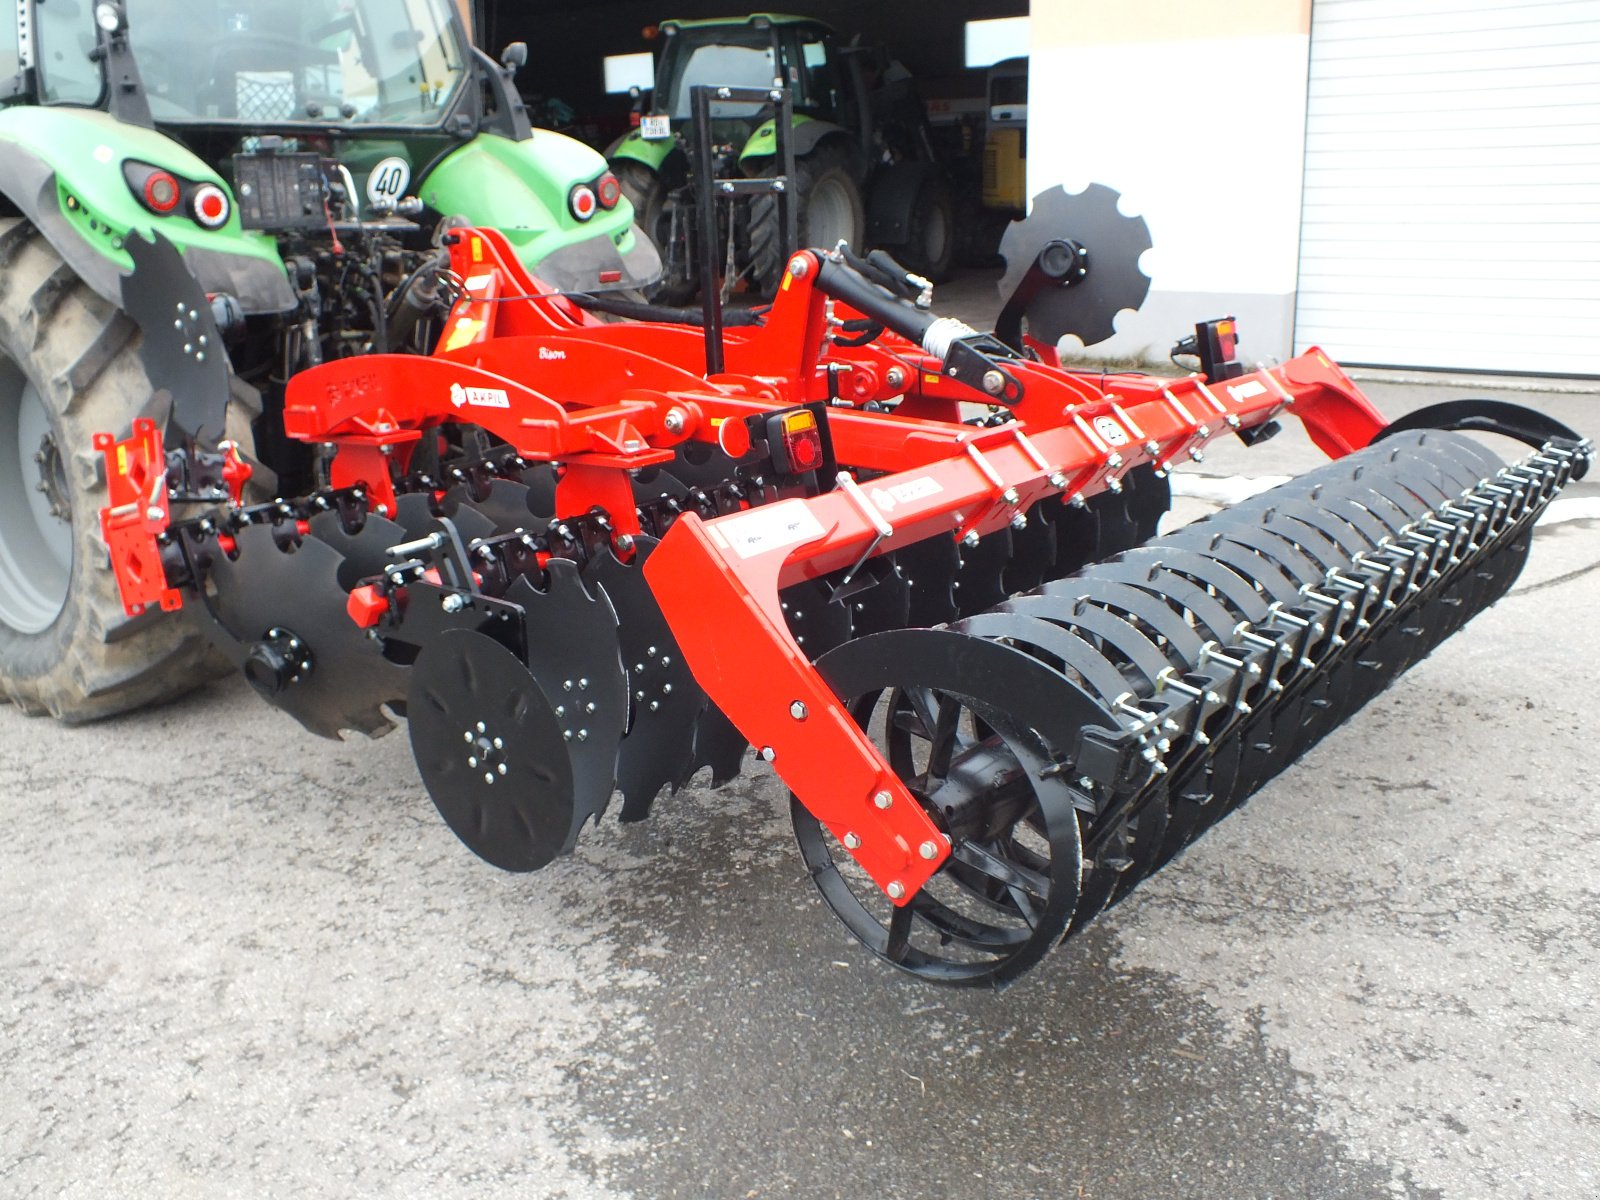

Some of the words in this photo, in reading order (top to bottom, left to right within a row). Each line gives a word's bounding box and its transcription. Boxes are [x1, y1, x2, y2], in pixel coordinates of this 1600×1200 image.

[375, 167, 402, 195] 40
[538, 346, 567, 360] Bison
[472, 391, 503, 404] AKPIL
